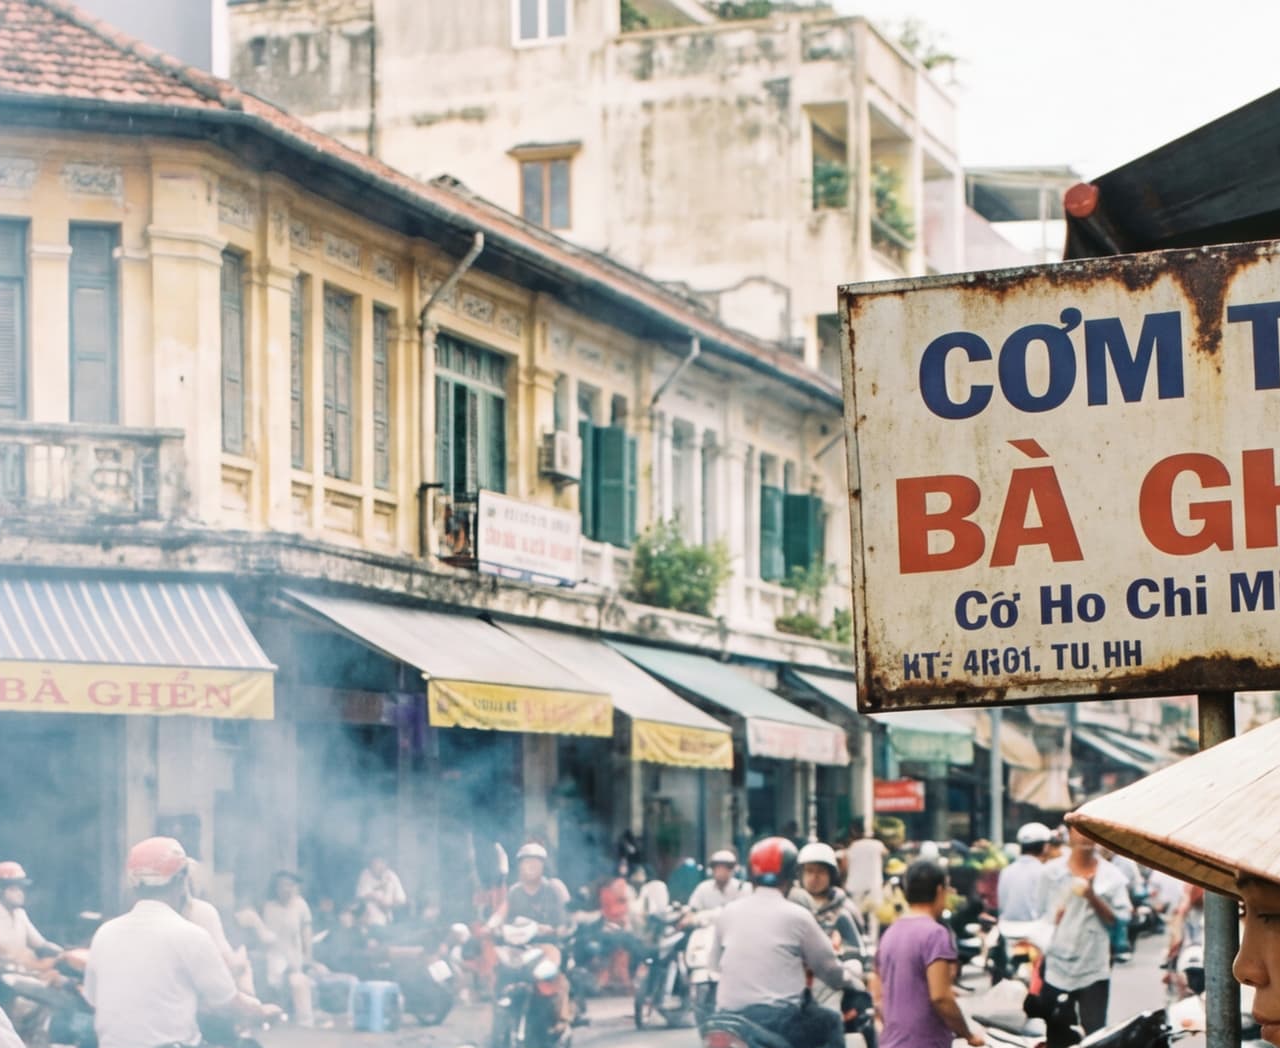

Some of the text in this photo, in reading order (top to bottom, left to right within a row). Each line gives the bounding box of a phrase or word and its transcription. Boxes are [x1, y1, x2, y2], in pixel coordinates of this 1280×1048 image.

[918, 306, 1185, 420] CƠM
[895, 437, 1084, 575] BÀ
[1039, 584, 1106, 625] Ho
[1126, 575, 1207, 619] Chi
